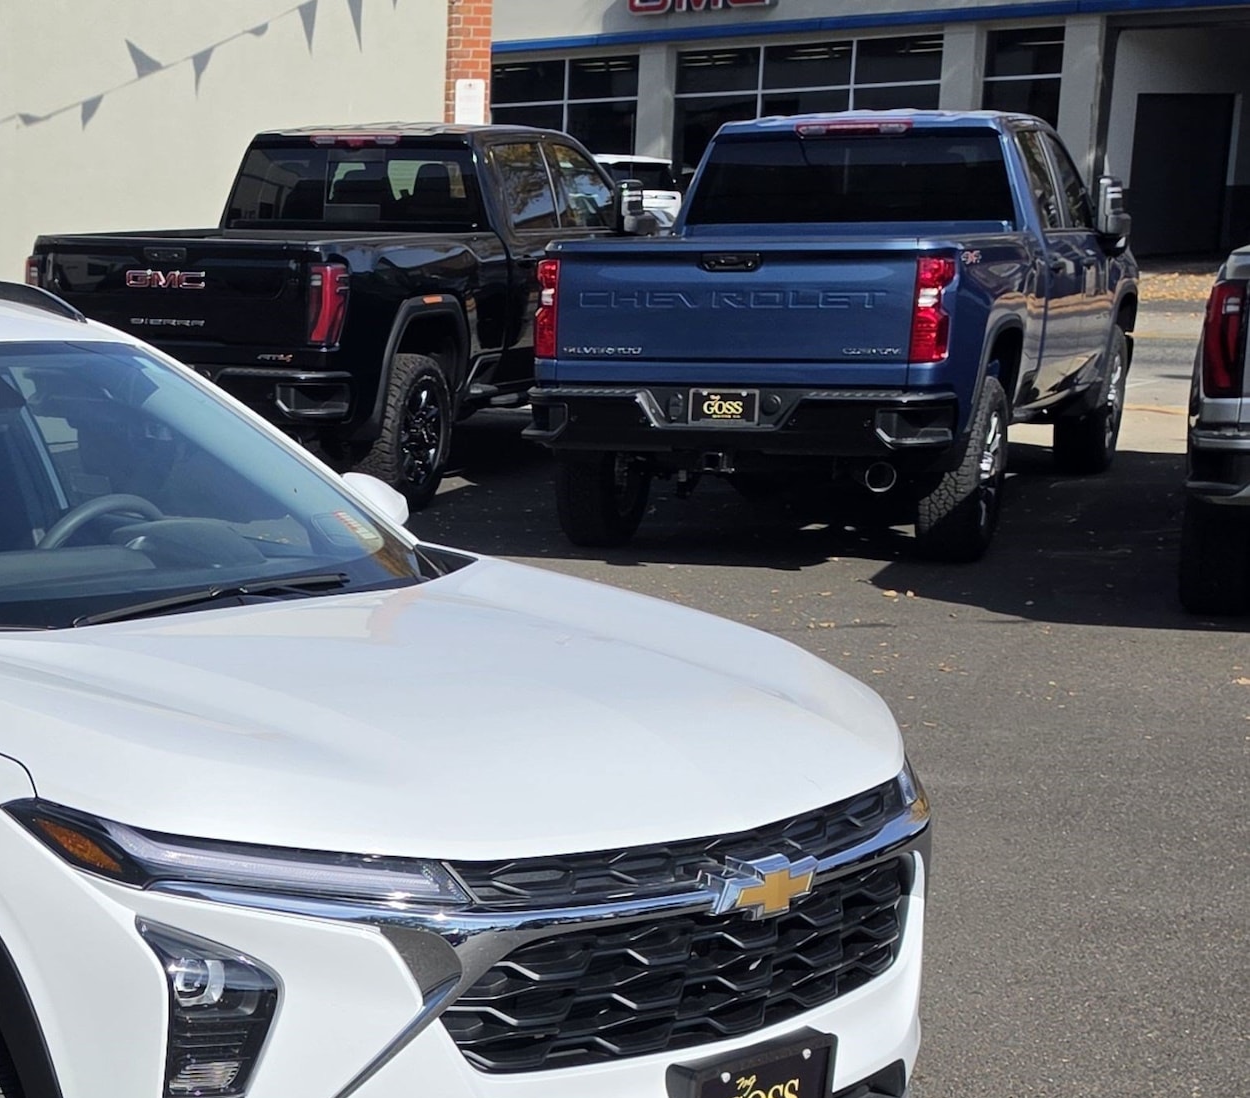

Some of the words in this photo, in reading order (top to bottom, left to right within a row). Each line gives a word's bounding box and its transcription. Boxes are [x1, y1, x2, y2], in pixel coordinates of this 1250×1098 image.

[126, 269, 206, 289] GMC
[579, 290, 888, 309] CHEVROLET
[702, 400, 744, 415] GOSS
